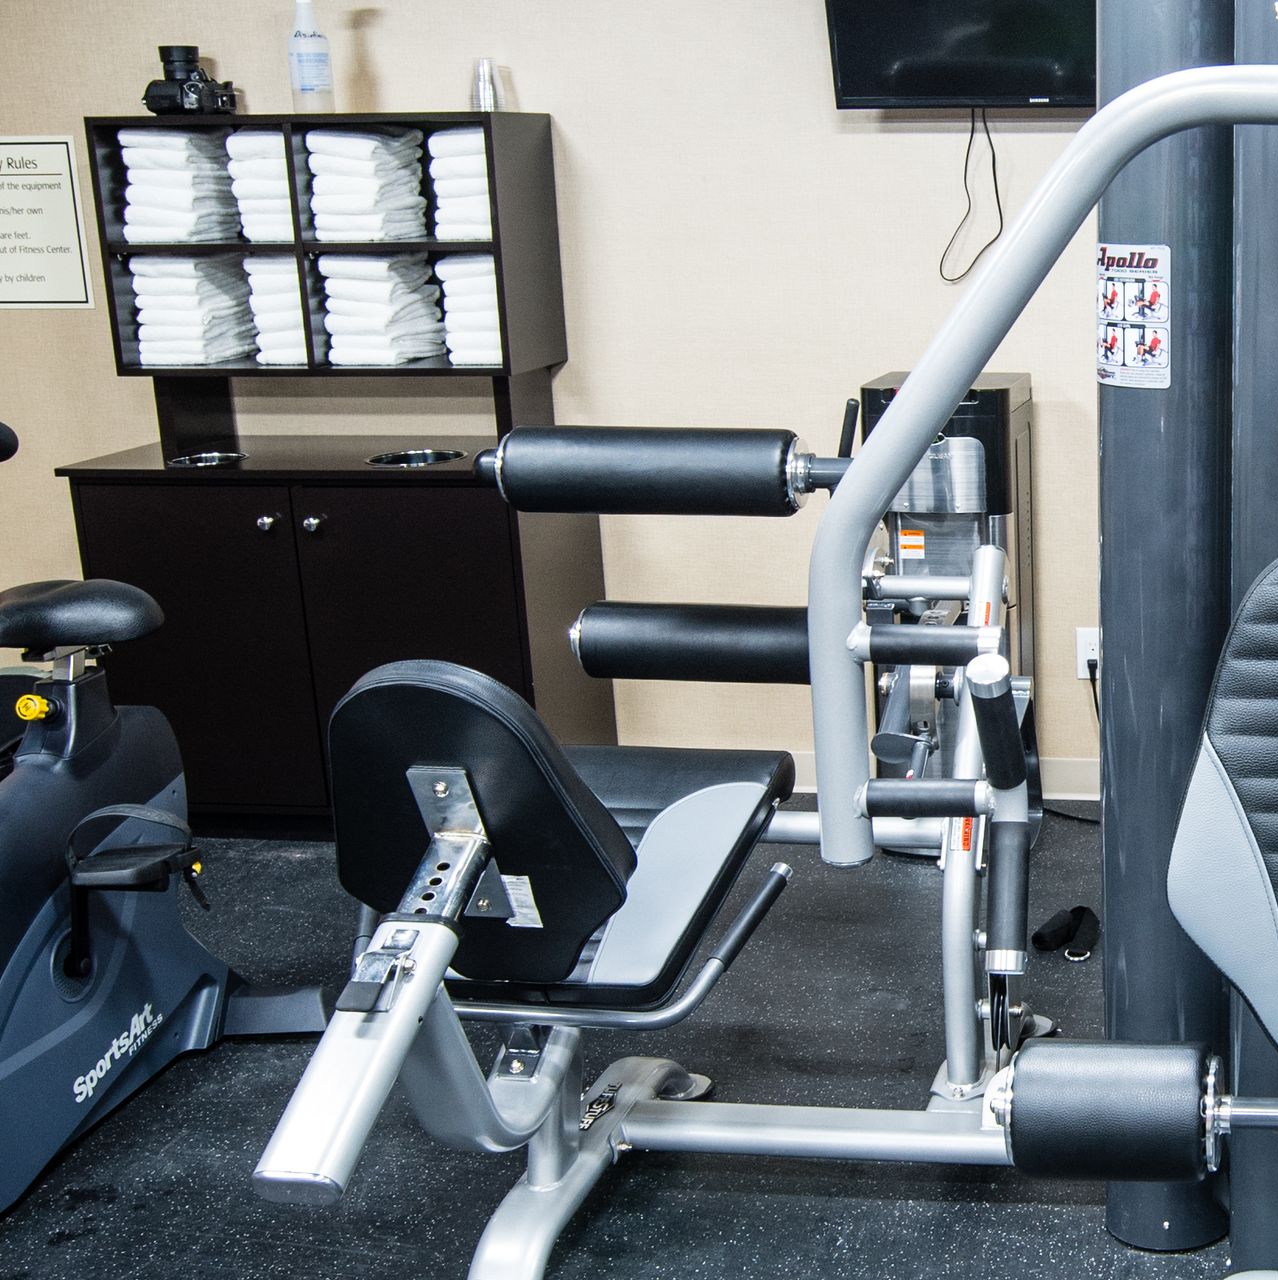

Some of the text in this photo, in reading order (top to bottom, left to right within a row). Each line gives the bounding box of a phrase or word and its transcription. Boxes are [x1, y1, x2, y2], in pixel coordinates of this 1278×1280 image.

[6, 156, 38, 169] Rules
[7, 182, 19, 190] the
[21, 182, 62, 191] equipment
[26, 207, 44, 215] own
[9, 245, 17, 254] of
[19, 245, 45, 254] Fitness
[4, 274, 14, 285] by
[16, 274, 46, 282] children
[128, 1013, 163, 1056] FITNESS
[73, 1003, 153, 1103] SportsArt
